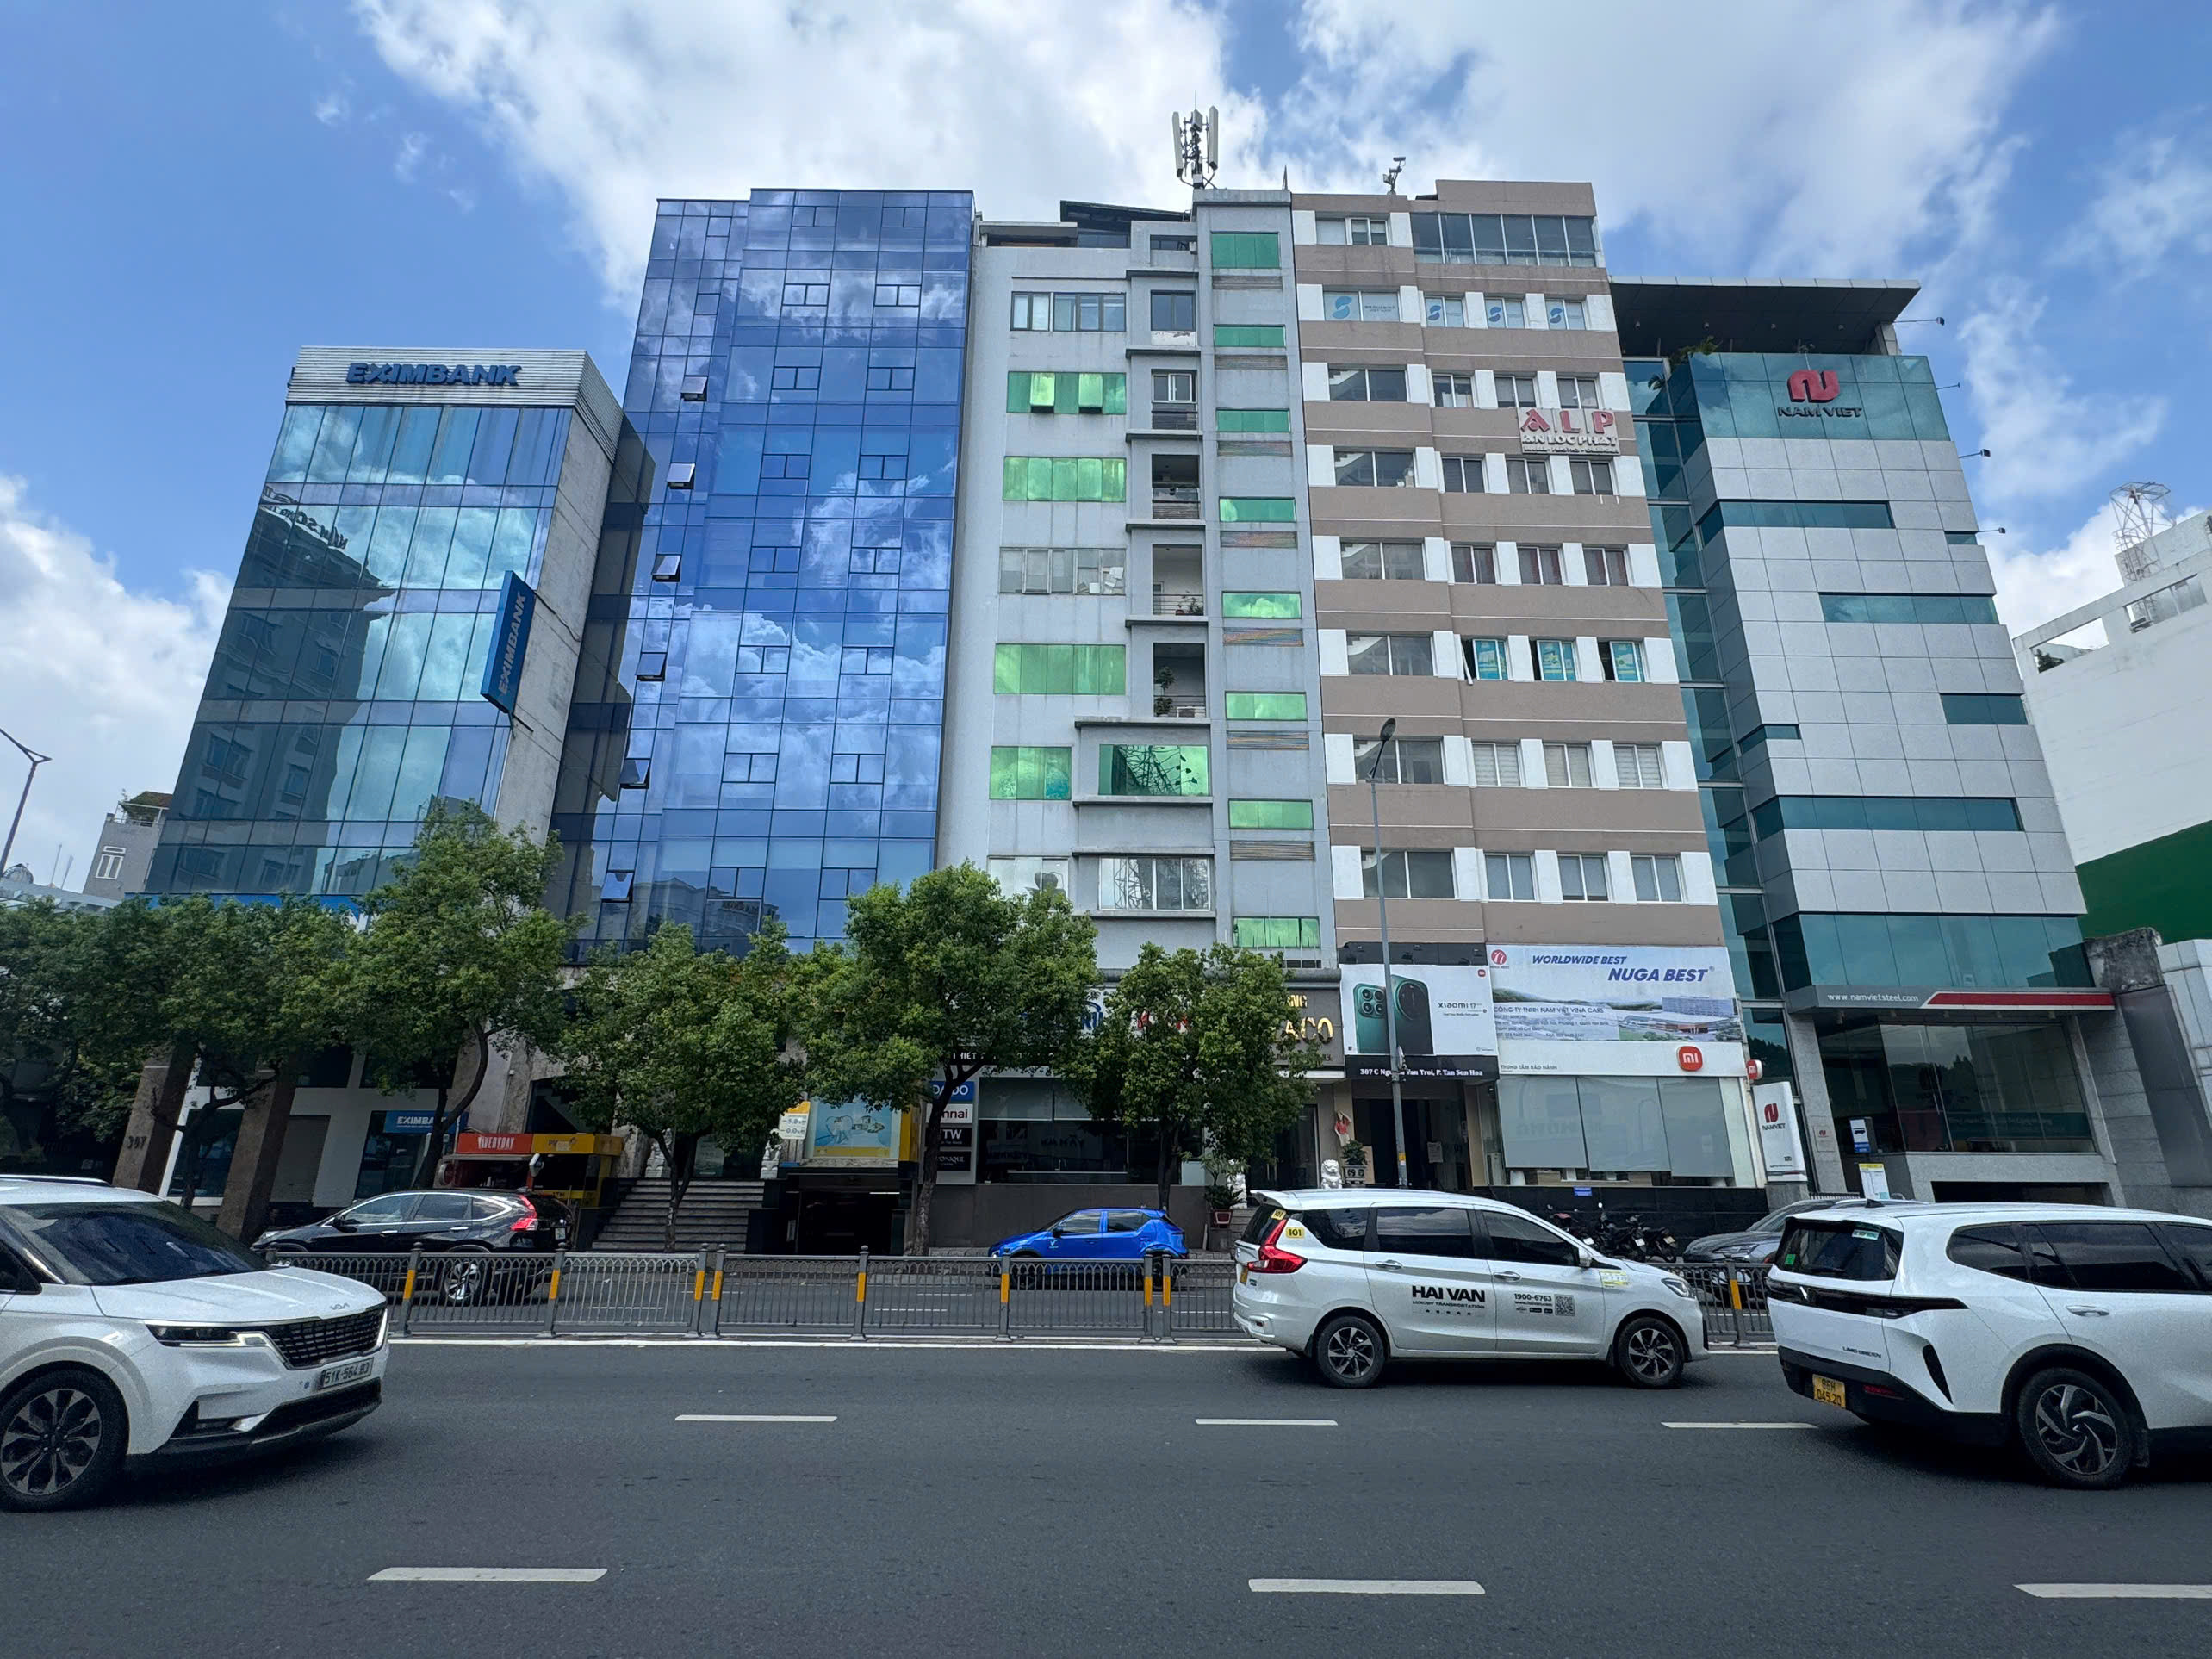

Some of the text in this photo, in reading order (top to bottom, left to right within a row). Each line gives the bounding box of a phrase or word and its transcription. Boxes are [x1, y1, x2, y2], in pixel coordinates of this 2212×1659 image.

[346, 363, 522, 386] EXIMBANK
[1778, 407, 1862, 418] NAM VIET
[497, 592, 525, 696] EXIMBANK
[1532, 955, 1627, 965] WORLDWIDE BEST
[1607, 968, 1708, 982] NUGA BEST
[1827, 993, 1919, 1002] www.namvietsteel.com
[942, 1109, 968, 1119] nnai
[397, 1115, 446, 1125] EXIMBA
[940, 1129, 962, 1140] TW
[1289, 1228, 1302, 1237] 101
[1412, 1285, 1485, 1302] HAI VAN
[1514, 1293, 1552, 1302] 1900-6763
